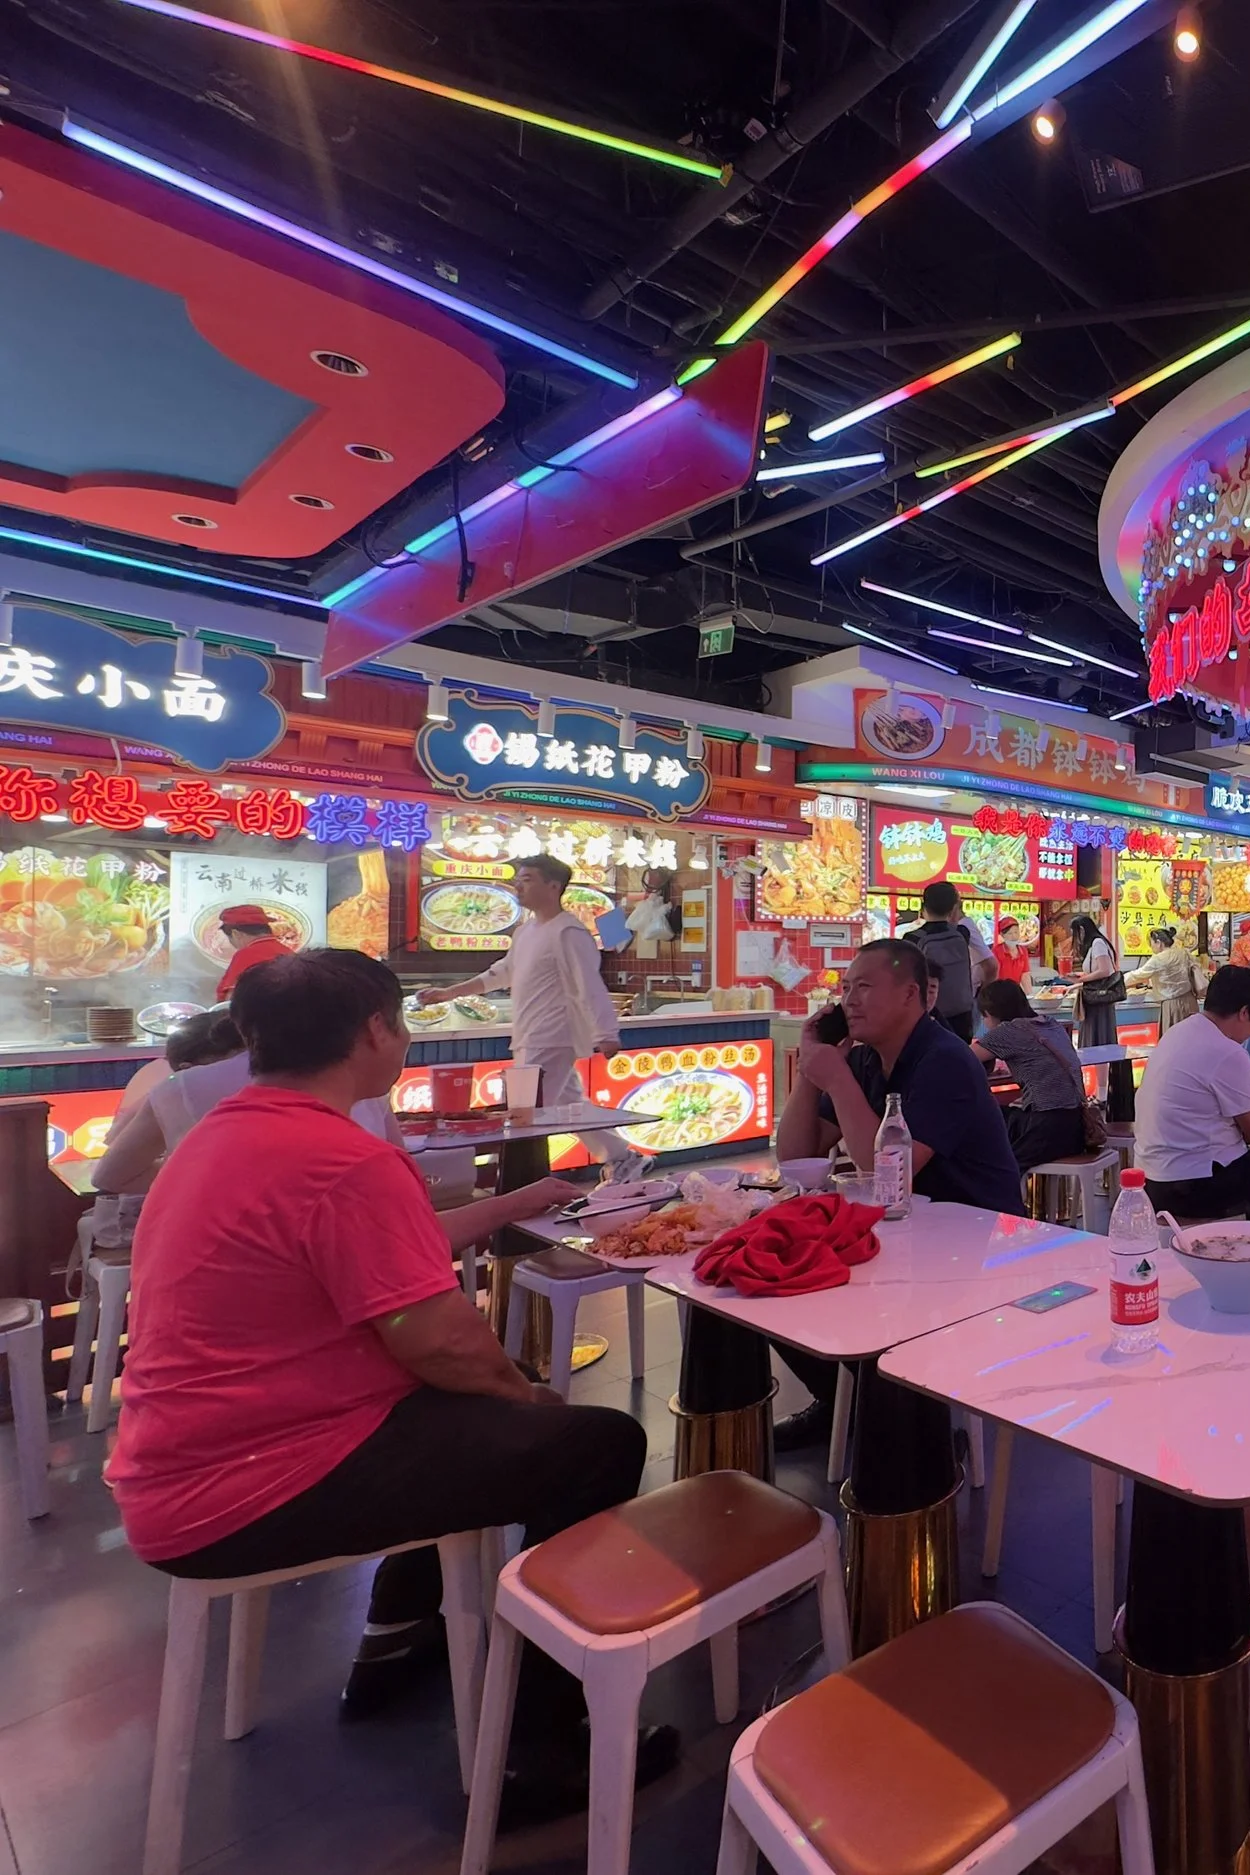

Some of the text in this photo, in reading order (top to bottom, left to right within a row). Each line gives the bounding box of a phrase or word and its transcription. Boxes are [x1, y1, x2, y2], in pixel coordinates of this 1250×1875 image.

[28, 734, 53, 745] HAI
[124, 746, 164, 758] WANG
[504, 730, 690, 788] 锡纸花甲粉
[252, 760, 290, 772] ZHONG
[291, 765, 306, 774] DE
[308, 768, 329, 777] LAO
[330, 770, 365, 781] SHANG
[366, 774, 384, 783] HAI
[871, 767, 945, 781] WANG XI LOU
[961, 775, 970, 784] JI
[971, 776, 980, 786] YI
[980, 778, 1009, 791] ZHONG
[1010, 782, 1020, 792] DE
[1020, 783, 1036, 794] LAO
[520, 792, 548, 801] ZHONG
[560, 797, 577, 805] LAO
[444, 863, 504, 878] 重庆小面
[195, 864, 309, 897] 云南过桥米线
[613, 1047, 756, 1076] 金陵鸭血粉丝汤
